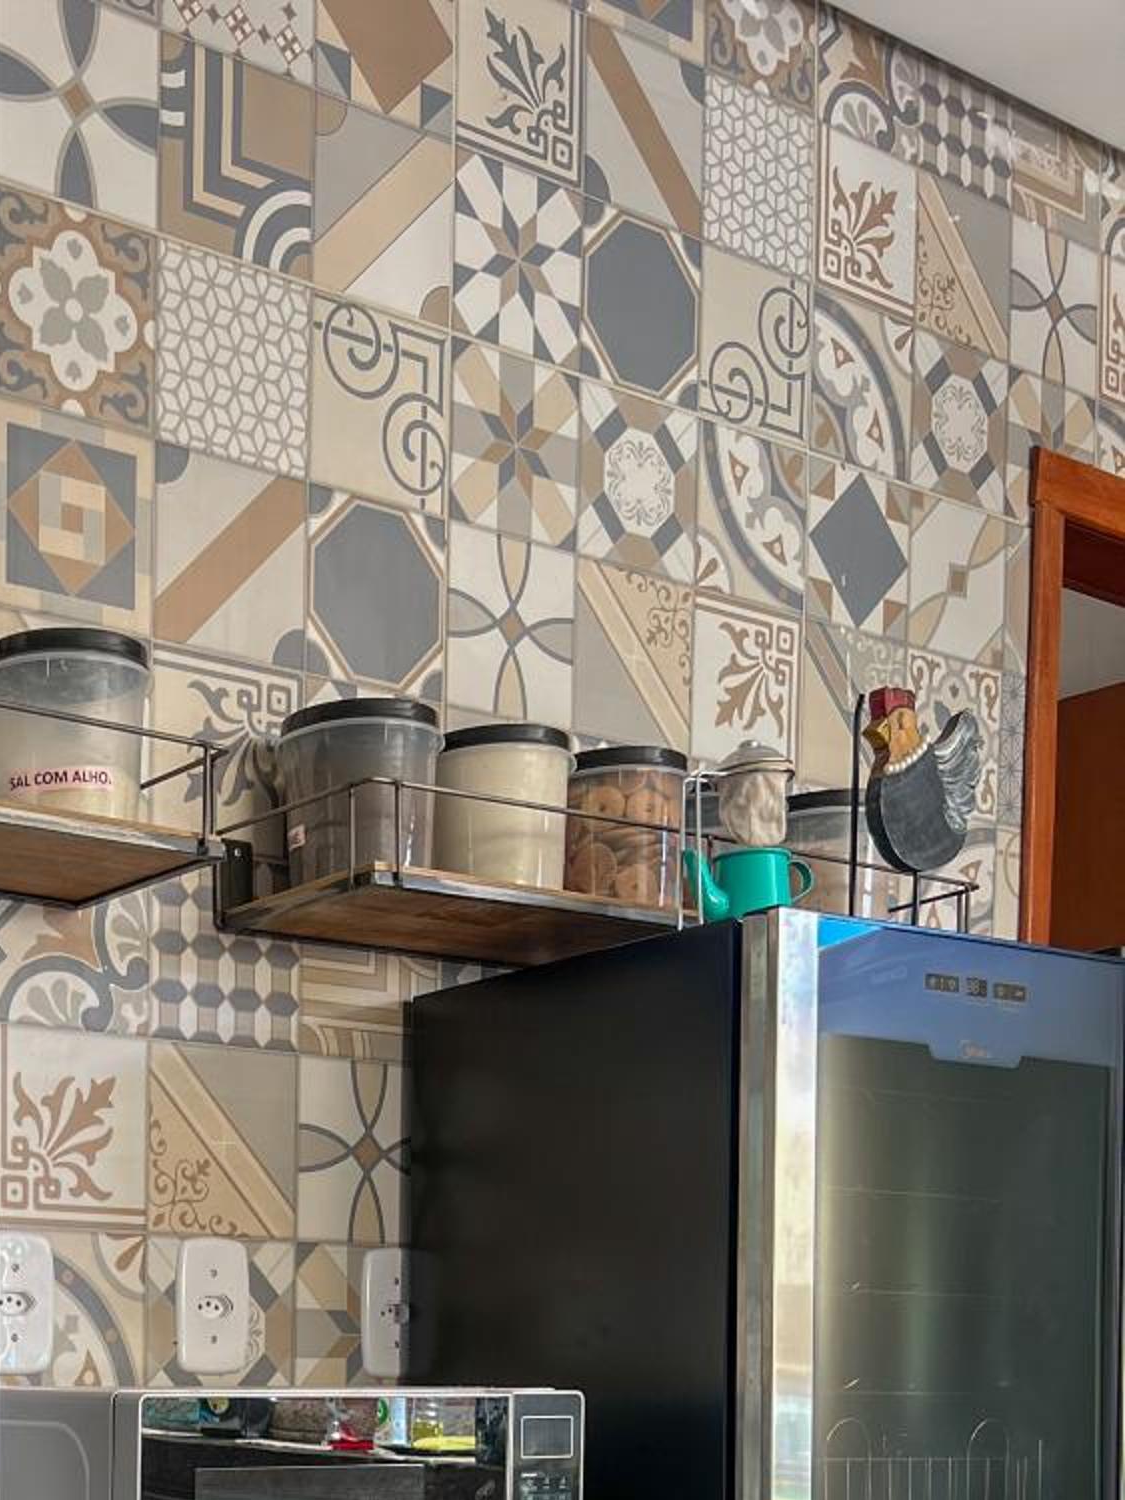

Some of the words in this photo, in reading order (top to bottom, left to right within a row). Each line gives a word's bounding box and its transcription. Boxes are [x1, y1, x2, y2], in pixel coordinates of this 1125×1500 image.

[9, 774, 30, 791] SAL
[34, 771, 68, 785] COM
[72, 770, 112, 785] ALHO.
